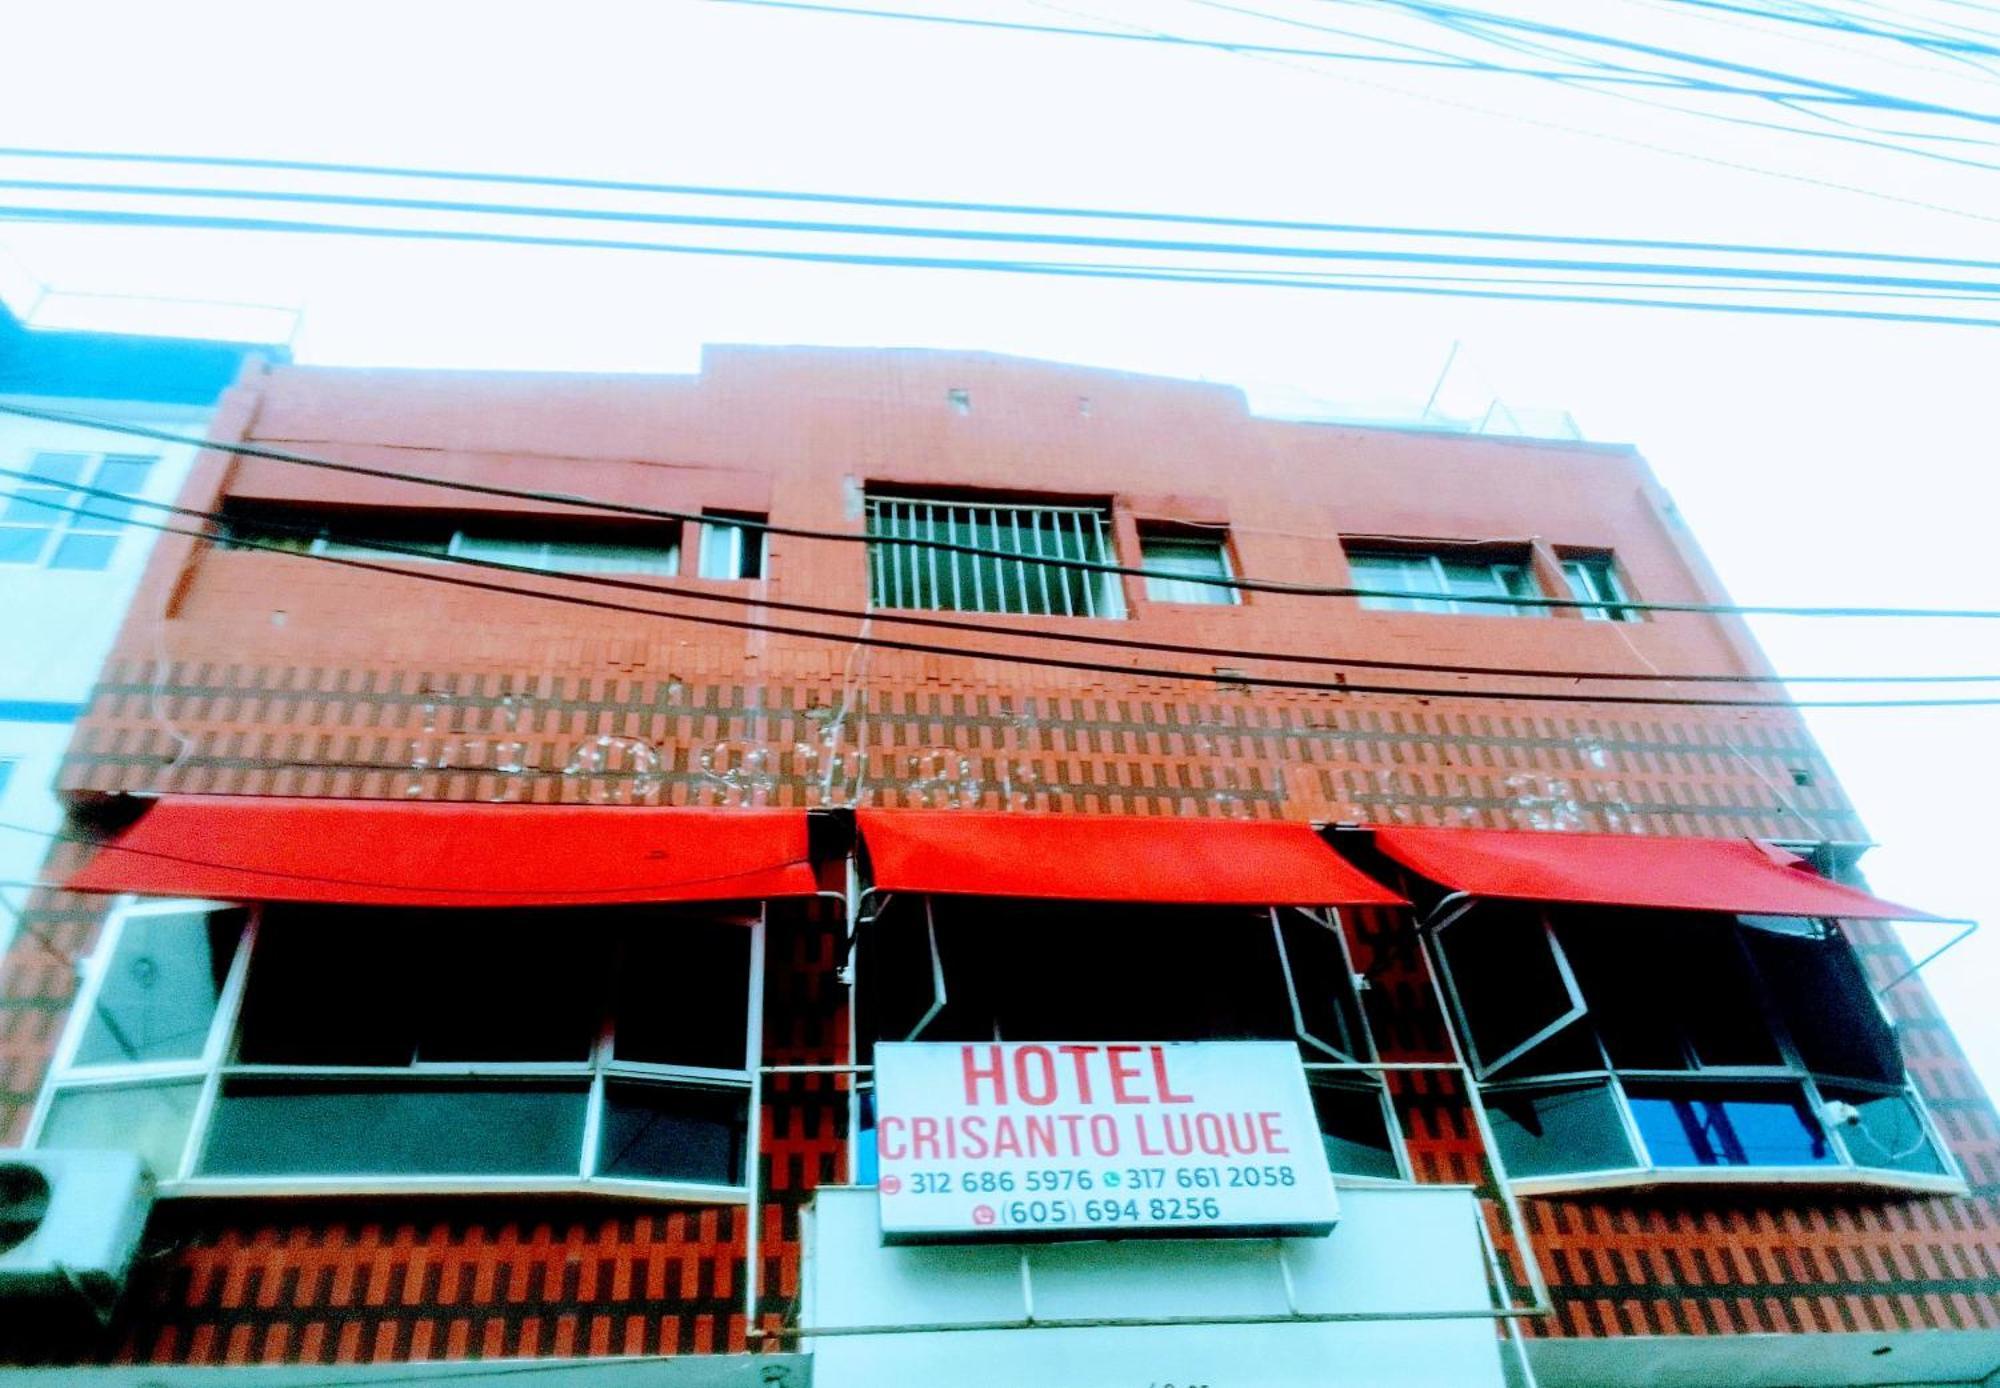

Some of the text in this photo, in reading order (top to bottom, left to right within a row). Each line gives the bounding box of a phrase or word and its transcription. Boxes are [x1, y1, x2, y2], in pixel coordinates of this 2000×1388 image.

[961, 1045, 1194, 1105] HOTEL
[878, 1112, 1290, 1160] CRISANTO LUQUE
[911, 1170, 1093, 1194] 312 686 5976
[1127, 1166, 1295, 1189] 317 661 2058
[1002, 1197, 1220, 1224] (605) 694 8256
